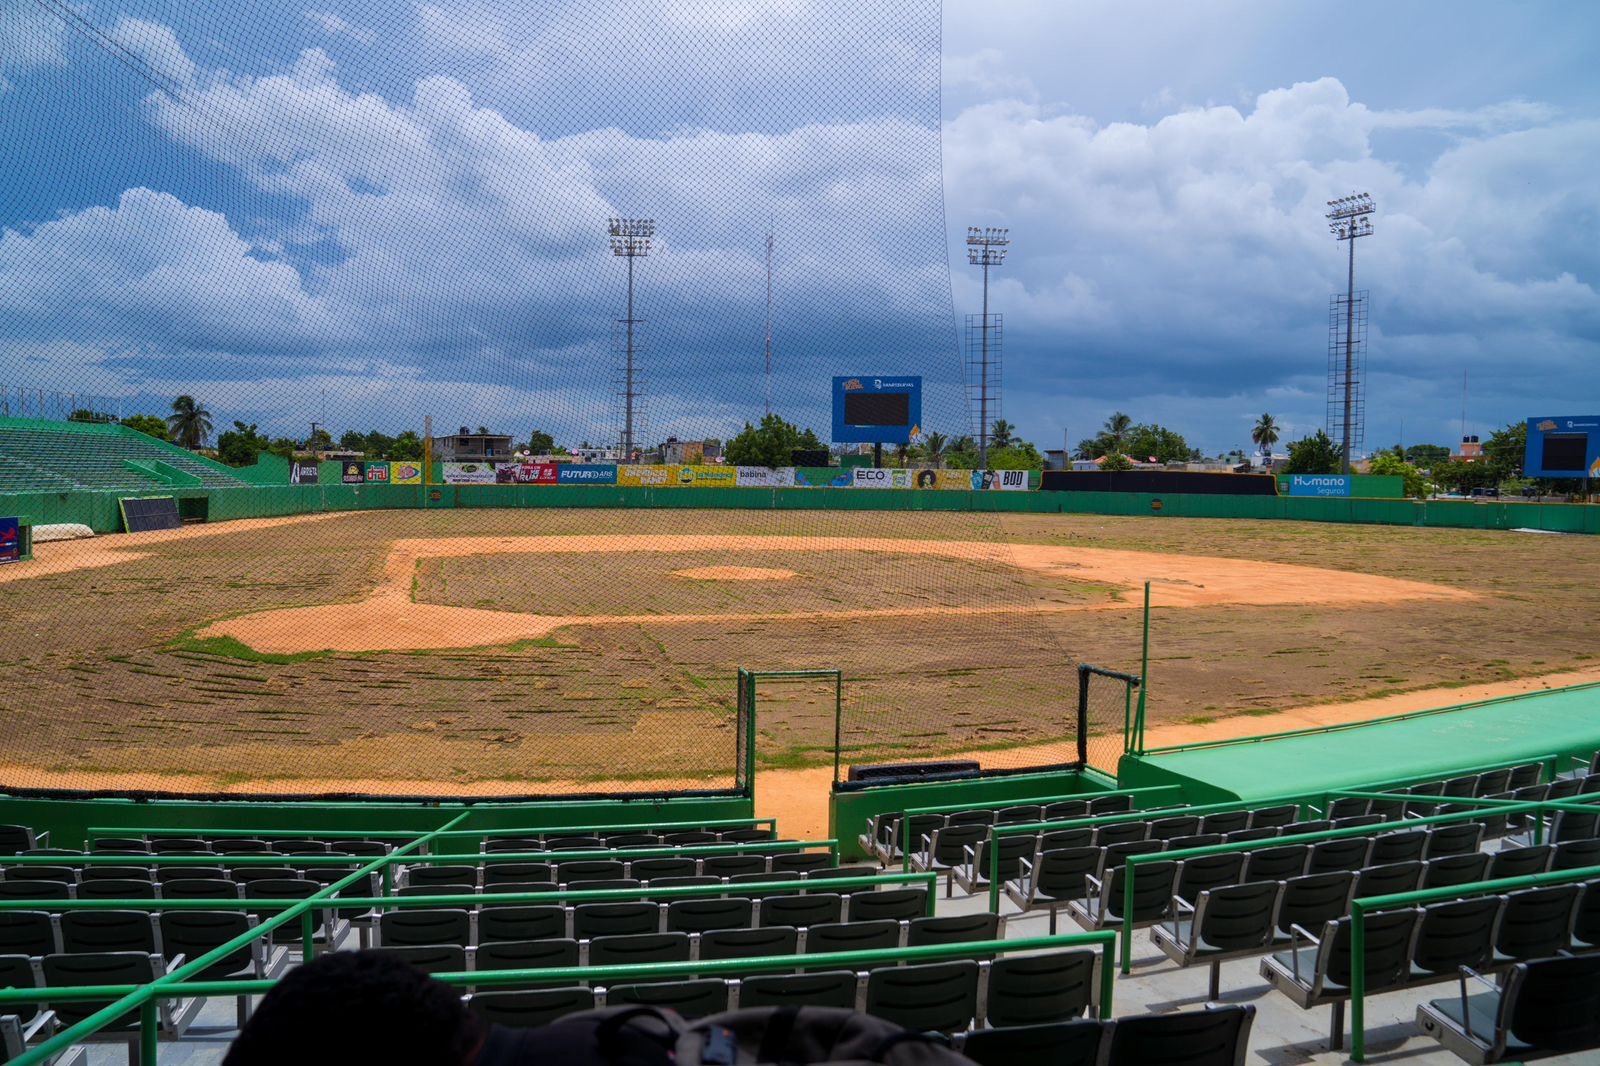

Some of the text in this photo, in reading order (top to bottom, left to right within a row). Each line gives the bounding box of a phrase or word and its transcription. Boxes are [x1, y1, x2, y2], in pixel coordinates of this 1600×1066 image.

[740, 470, 767, 479] babina
[856, 470, 885, 480] ECO
[1294, 475, 1345, 486] Humano
[1317, 487, 1345, 496] Seguros
